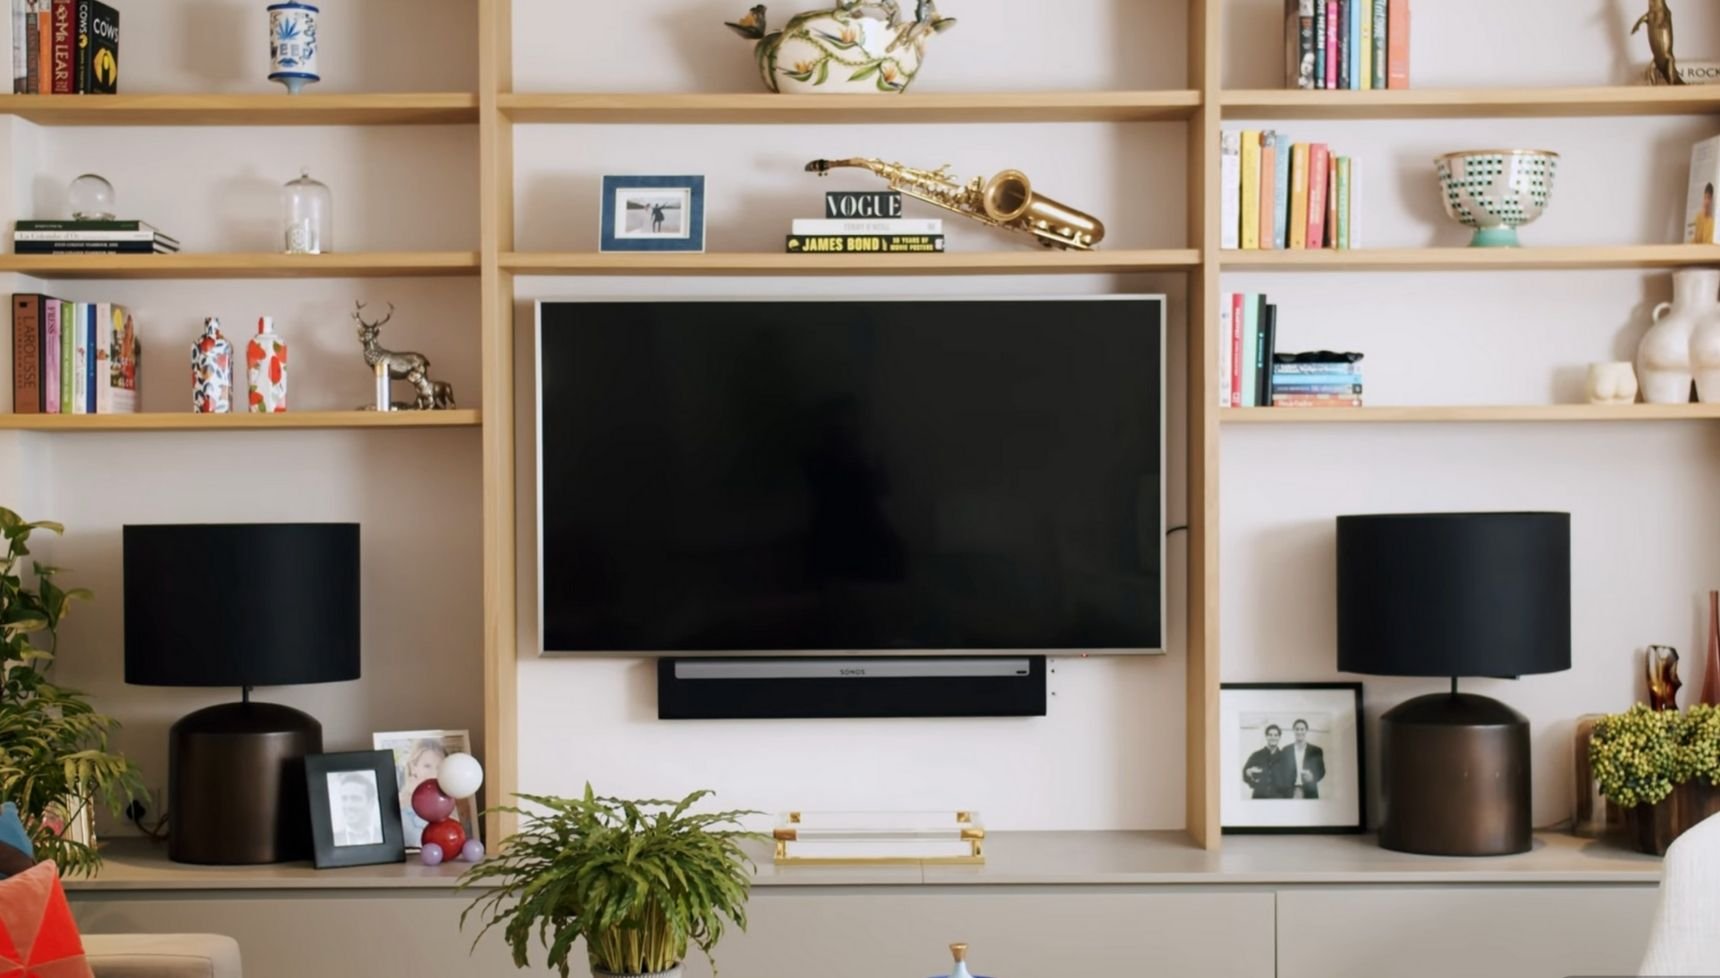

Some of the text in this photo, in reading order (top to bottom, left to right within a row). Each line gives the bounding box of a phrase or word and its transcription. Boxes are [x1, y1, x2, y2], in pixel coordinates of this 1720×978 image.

[79, 4, 88, 33] COWS
[93, 19, 118, 43] COWS
[55, 45, 69, 80] LEAR
[827, 195, 902, 217] VOGUE
[802, 237, 880, 251] JAMES BOND
[23, 316, 36, 389] LAROUSSE
